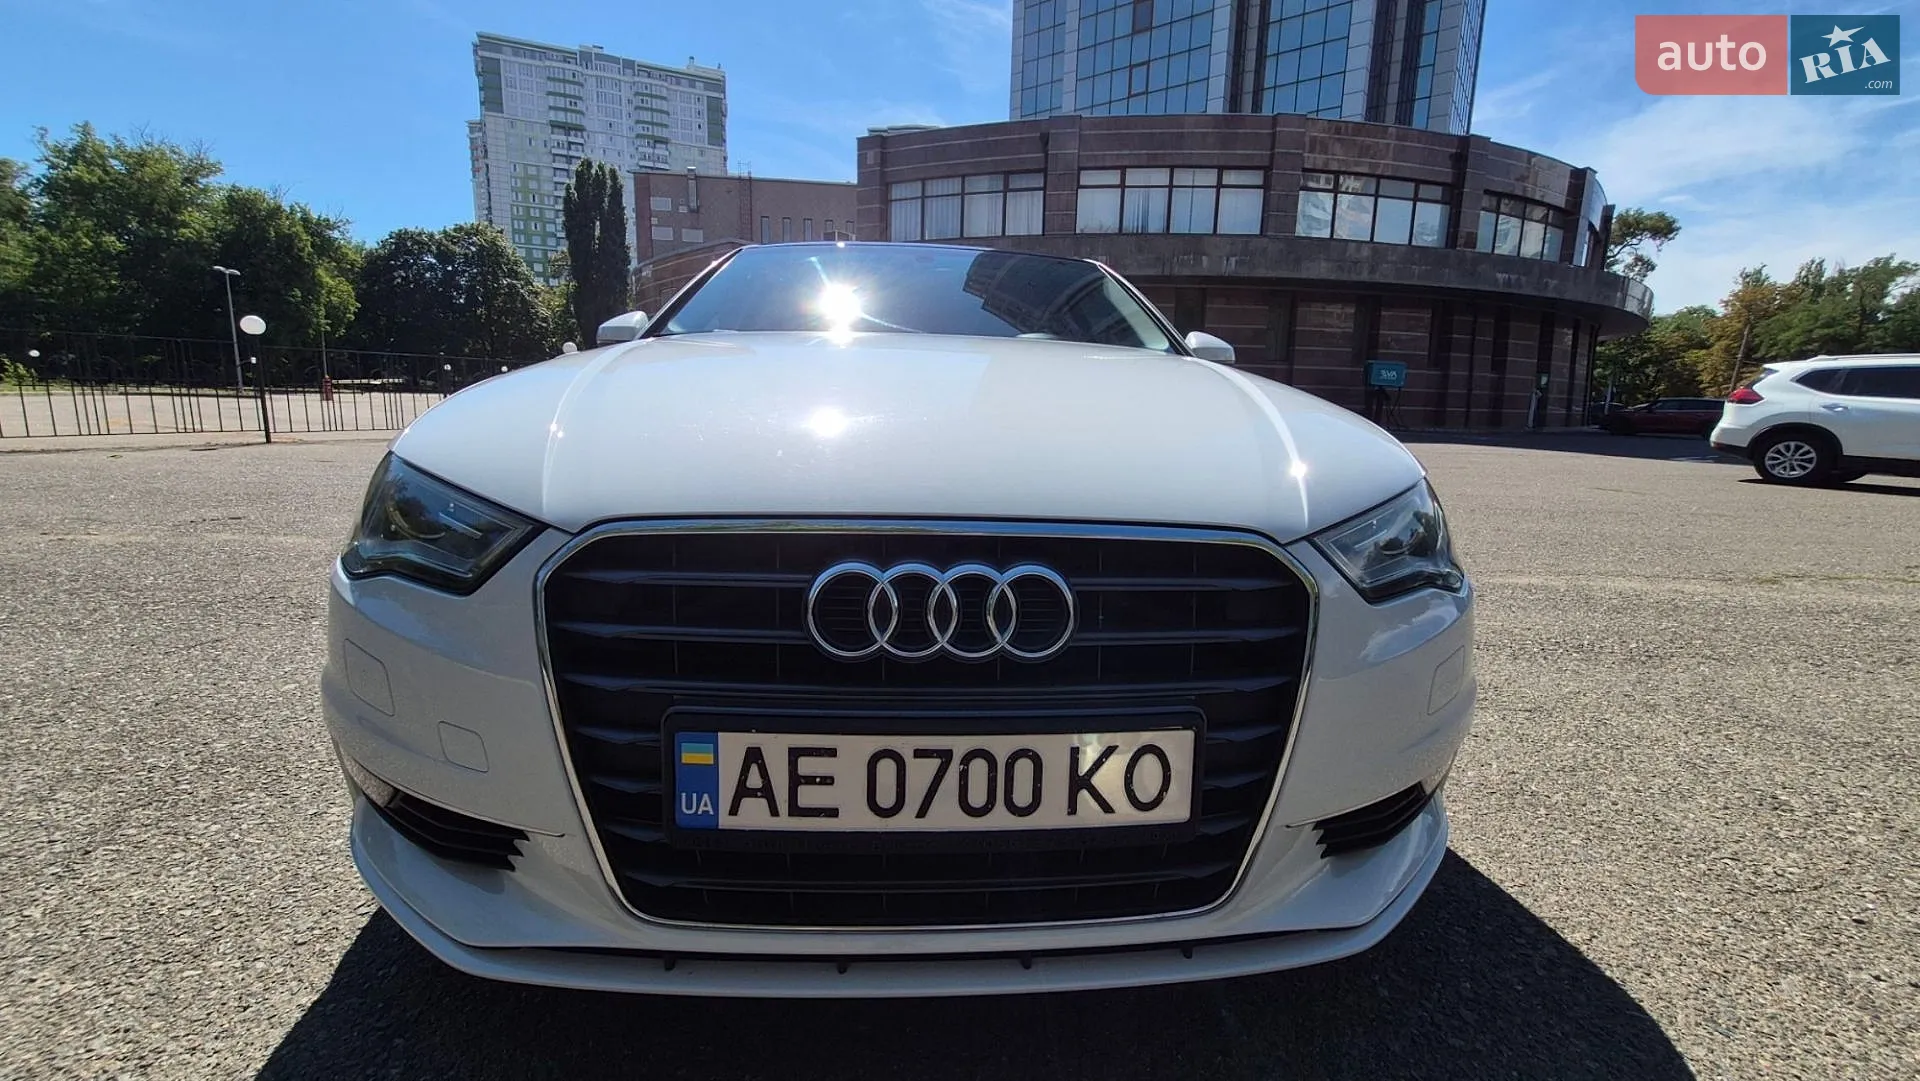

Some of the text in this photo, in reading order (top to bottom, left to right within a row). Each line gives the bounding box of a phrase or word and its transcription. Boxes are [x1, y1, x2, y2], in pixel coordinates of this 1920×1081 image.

[681, 792, 714, 816] UA
[728, 743, 1171, 819] AE 0700 KO
